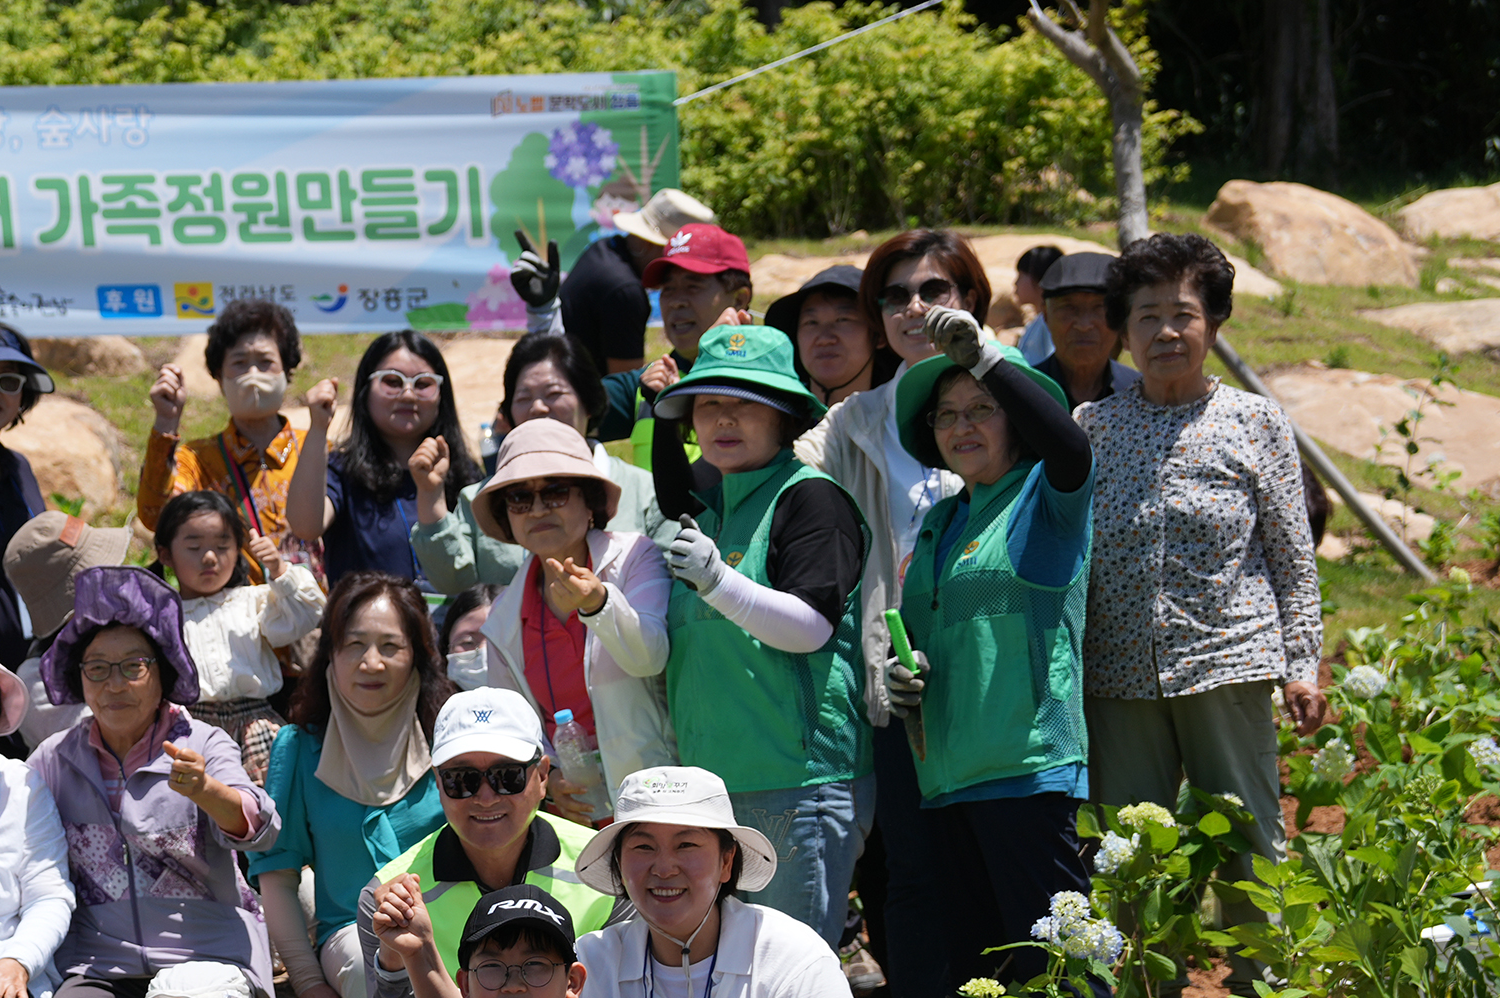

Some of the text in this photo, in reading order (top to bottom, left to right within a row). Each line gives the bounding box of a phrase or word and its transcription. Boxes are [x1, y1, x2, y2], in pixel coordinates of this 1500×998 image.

[35, 102, 153, 150] 숲사랑
[34, 165, 483, 247] 가족정원만들기
[357, 285, 429, 313] 장흥군
